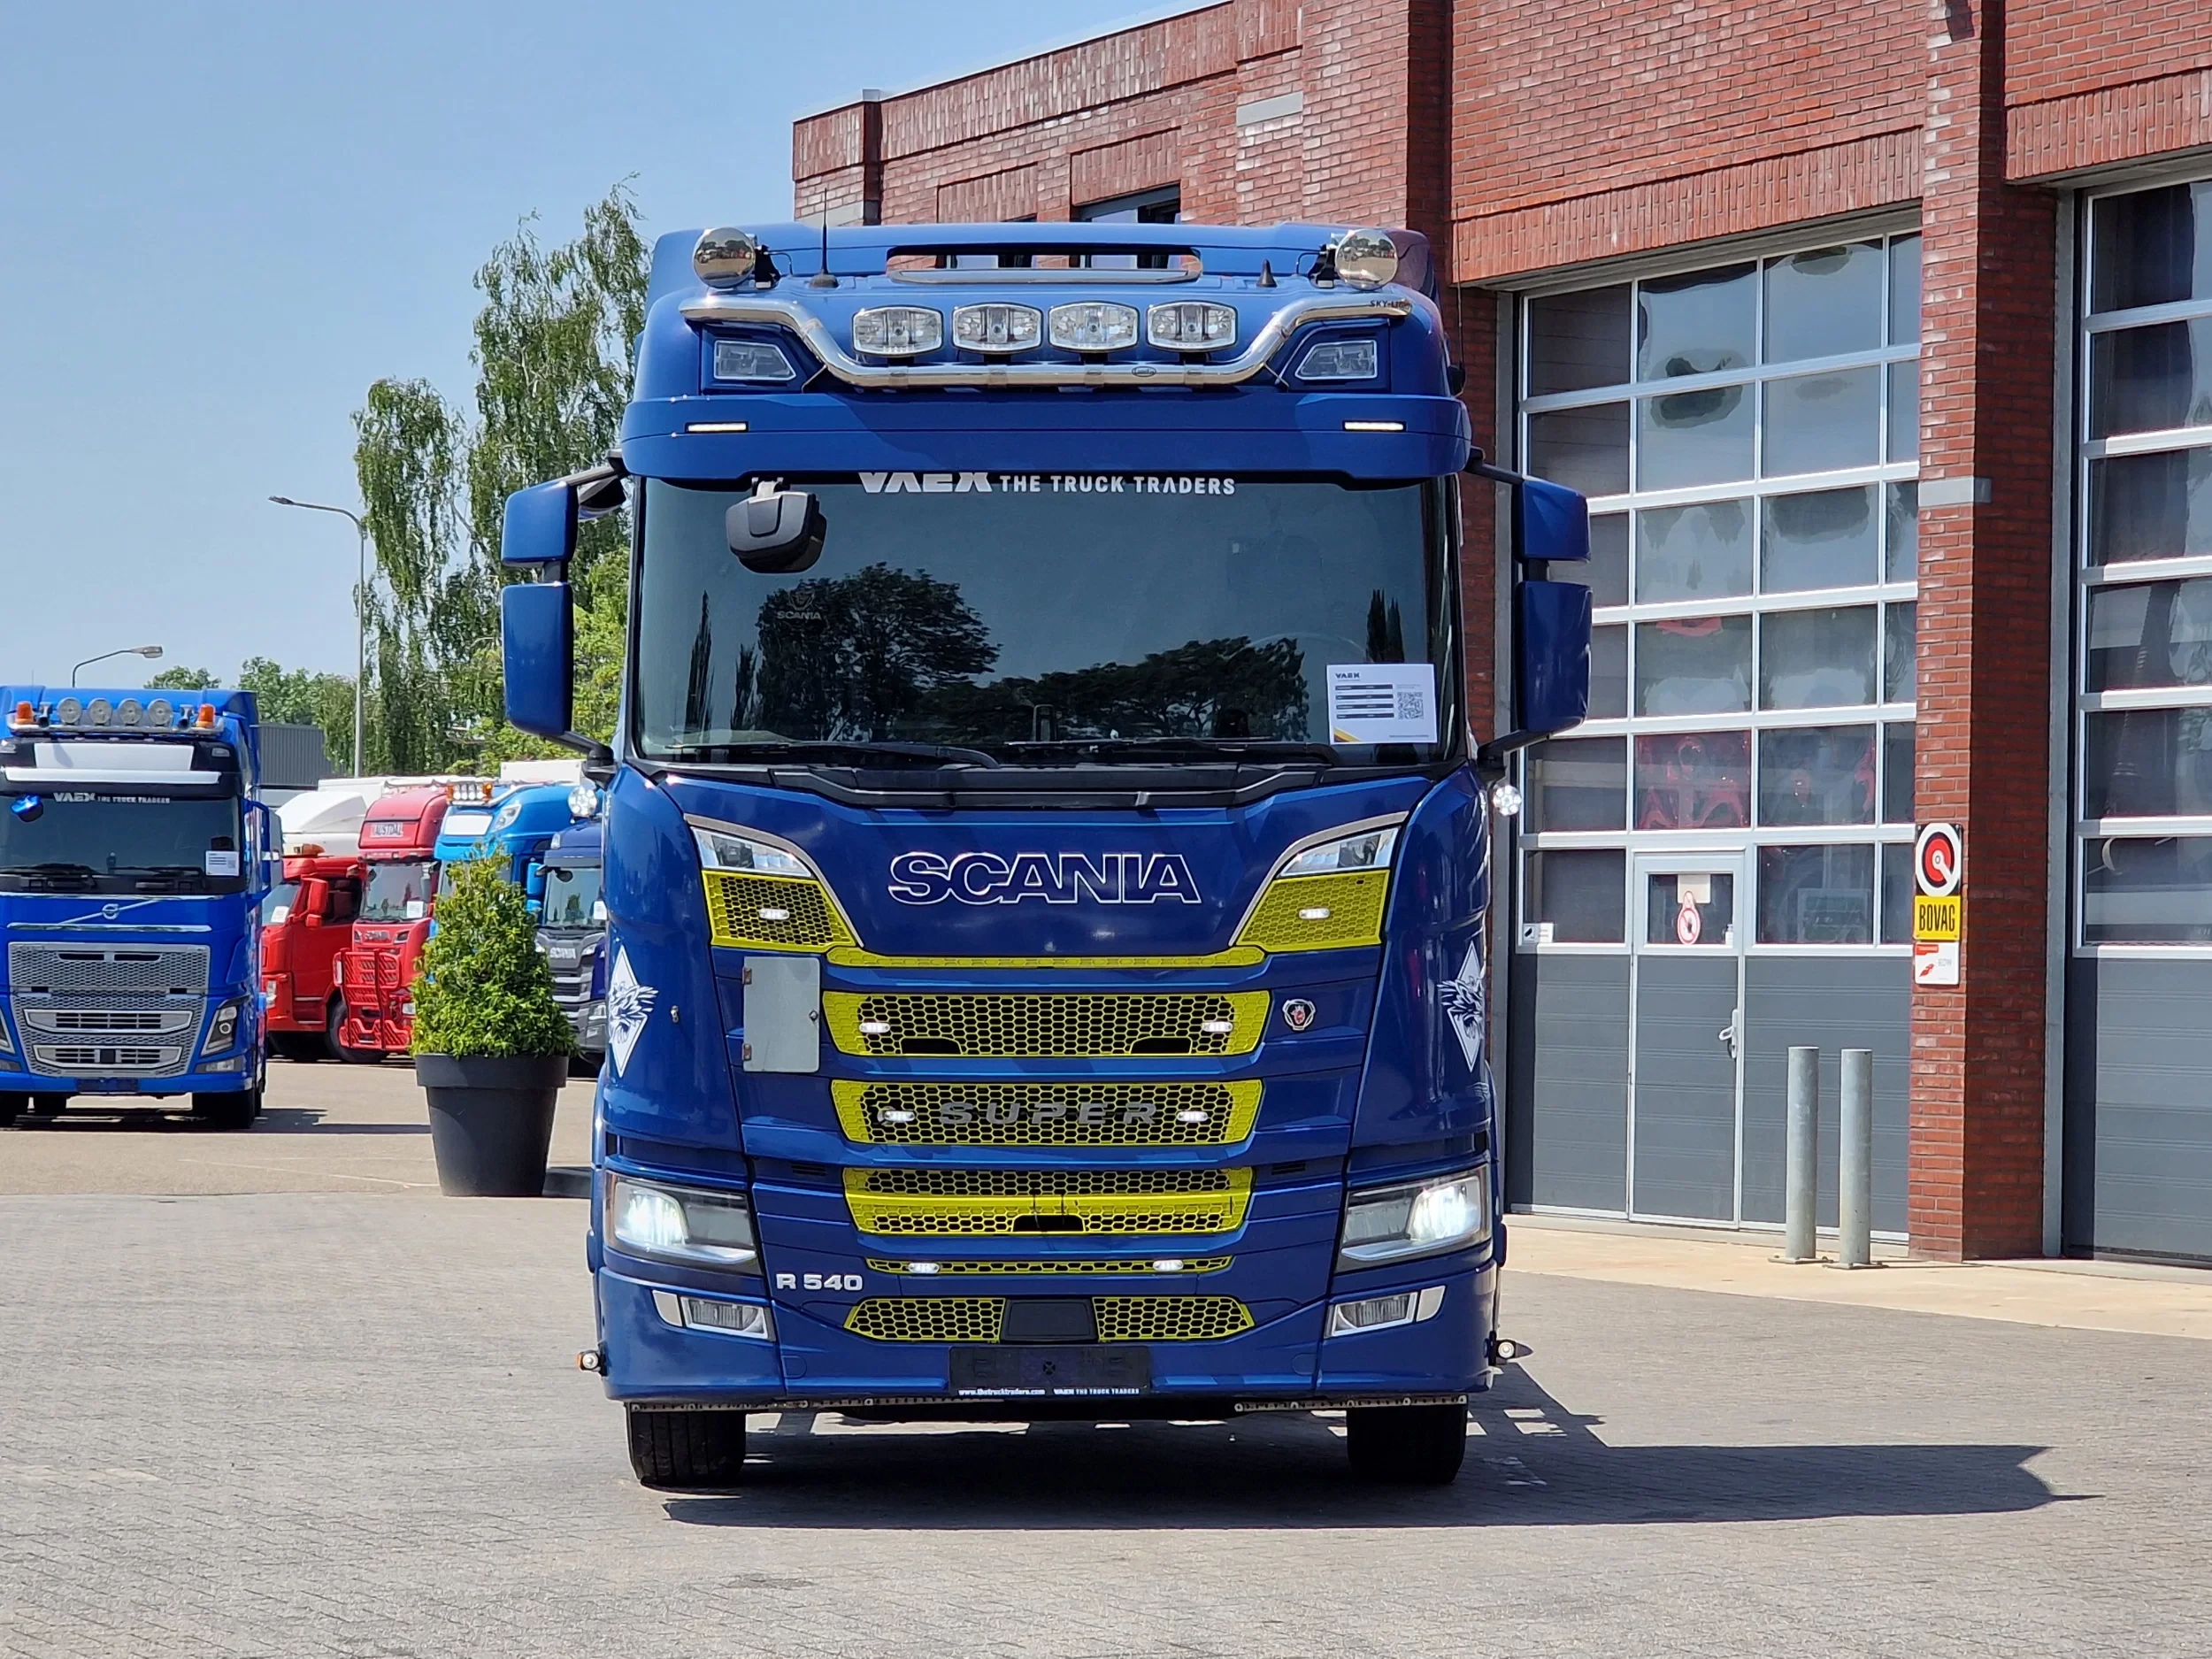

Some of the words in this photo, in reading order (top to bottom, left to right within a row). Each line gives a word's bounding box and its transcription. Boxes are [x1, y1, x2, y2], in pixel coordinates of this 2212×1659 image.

[858, 472, 993, 493] VAEX
[1000, 475, 1041, 493] THE
[1050, 475, 1125, 494] TRUCK
[1133, 476, 1236, 495] TRADERS
[777, 611, 821, 619] SCANIA
[887, 851, 1202, 904] SCANIA
[1919, 904, 1955, 932] BOVAG
[939, 1102, 1157, 1125] SUPER
[776, 1273, 796, 1289] R
[803, 1274, 863, 1291] 540
